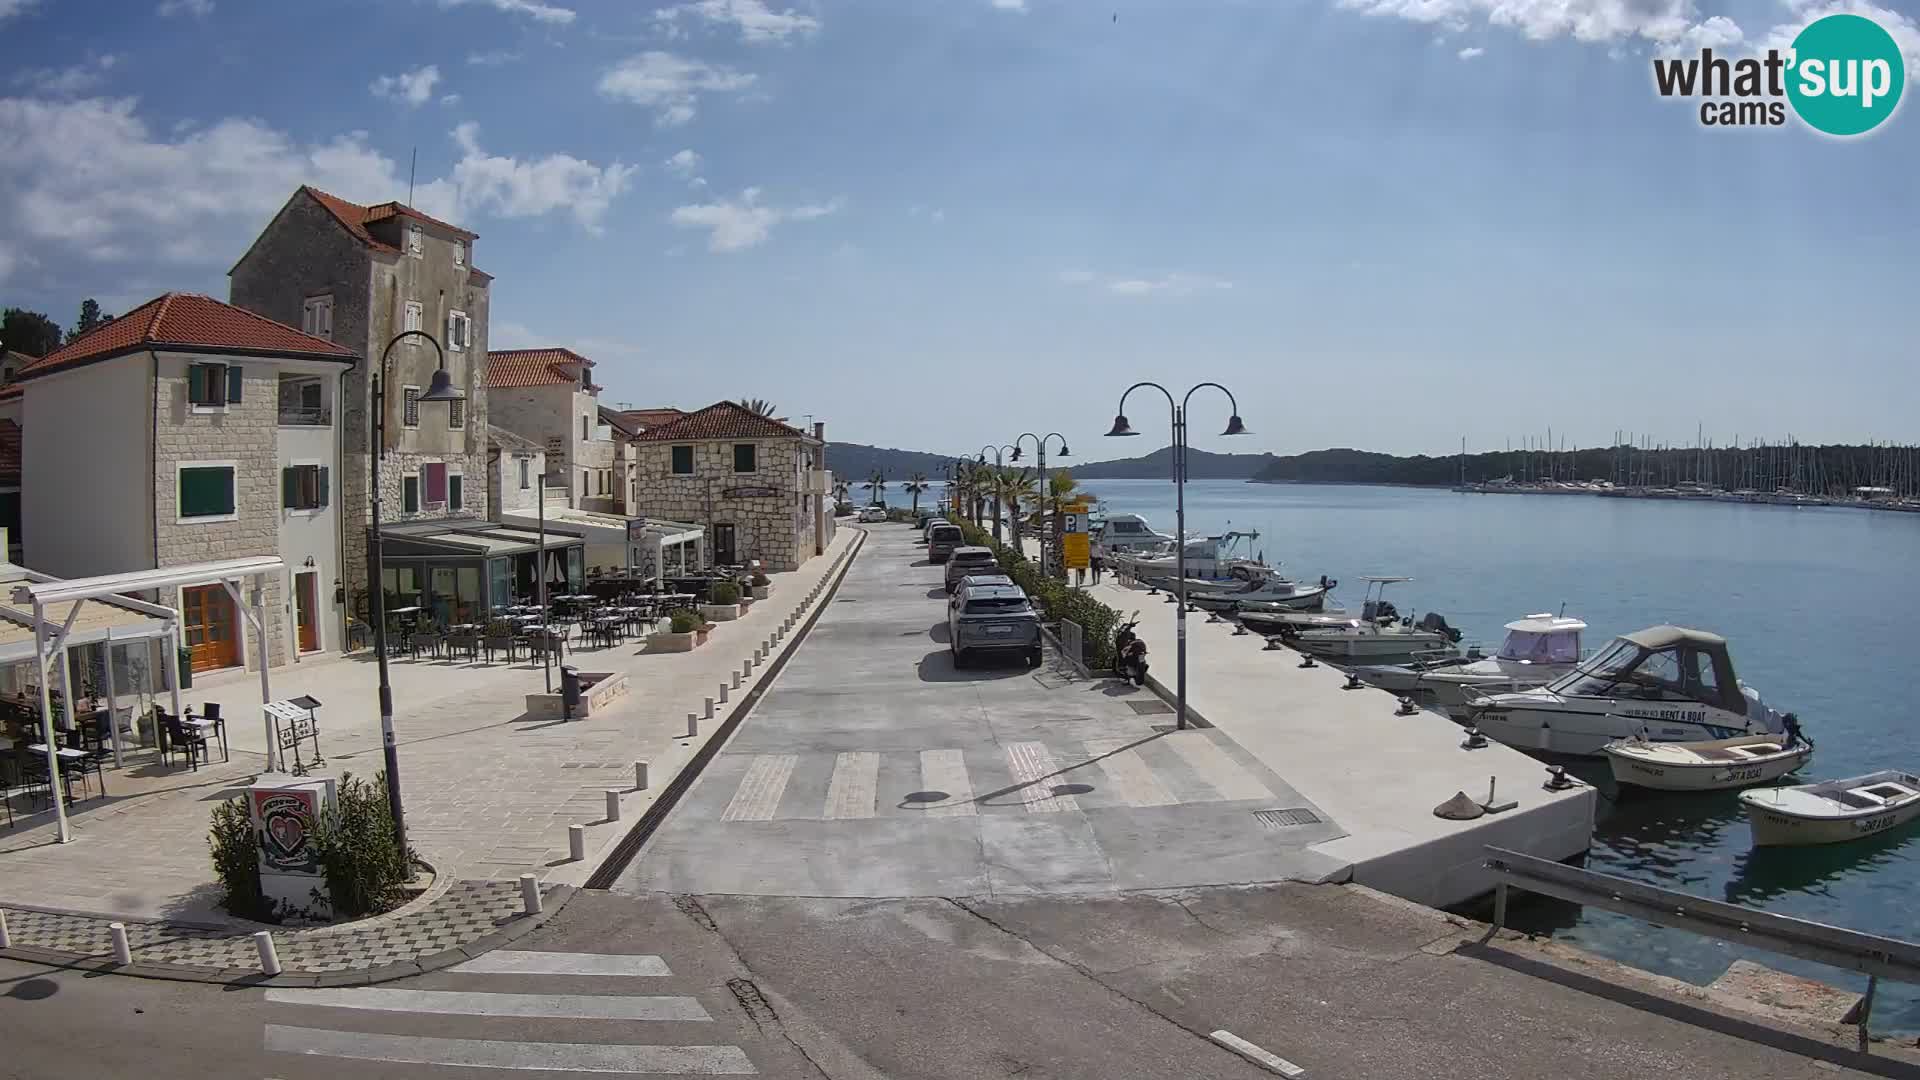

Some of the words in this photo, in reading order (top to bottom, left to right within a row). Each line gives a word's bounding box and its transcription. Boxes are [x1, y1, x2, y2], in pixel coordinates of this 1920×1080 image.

[1065, 515, 1076, 530] P
[1660, 710, 1678, 720] RENT
[1687, 711, 1706, 722] BOAT
